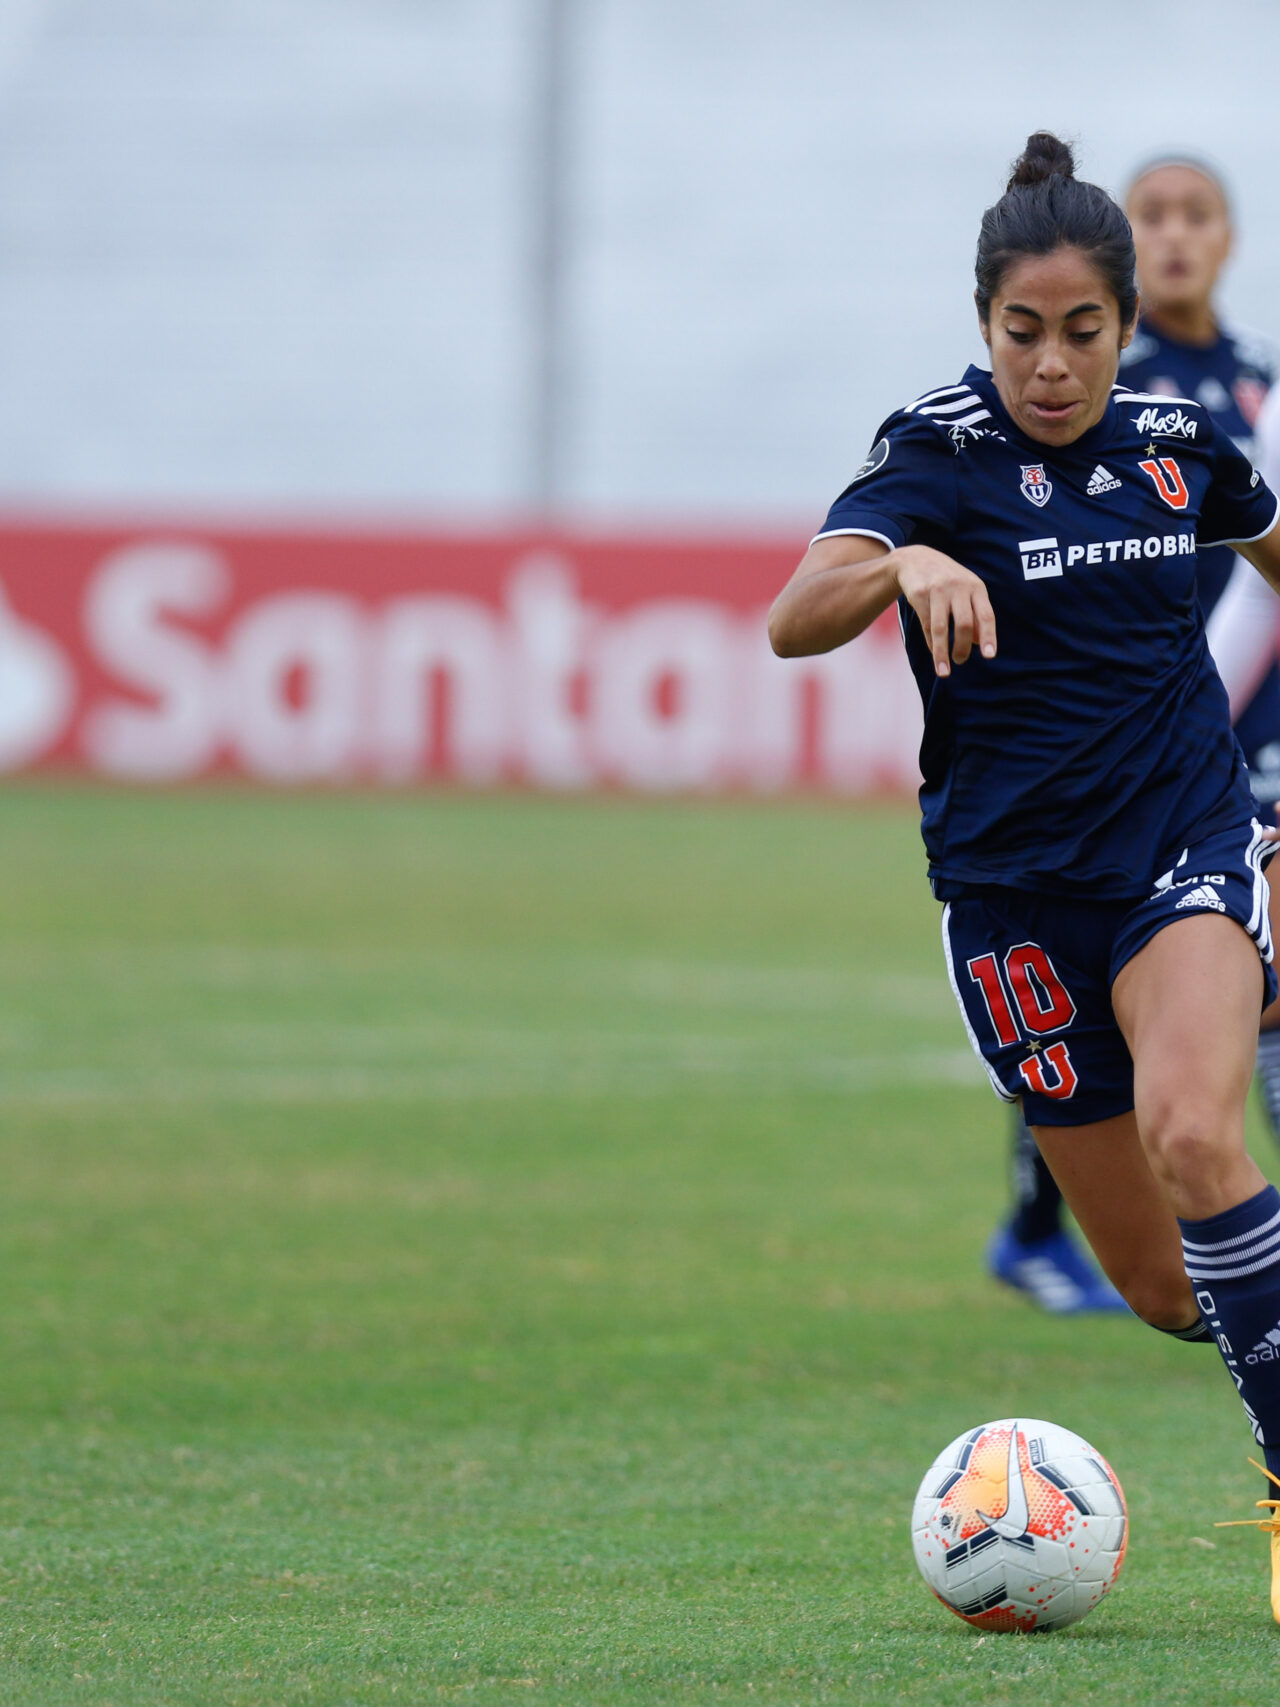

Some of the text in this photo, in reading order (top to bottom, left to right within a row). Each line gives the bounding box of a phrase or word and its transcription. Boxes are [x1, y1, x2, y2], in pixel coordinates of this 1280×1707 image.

[1130, 407, 1198, 439] Alaska
[1086, 479, 1122, 495] adidas
[1137, 457, 1190, 510] U
[1027, 551, 1057, 570] BR
[1175, 898, 1227, 913] adidas
[966, 941, 1077, 1048] 10
[1018, 1040, 1079, 1100] U
[1192, 1278, 1244, 1391] VISIO
